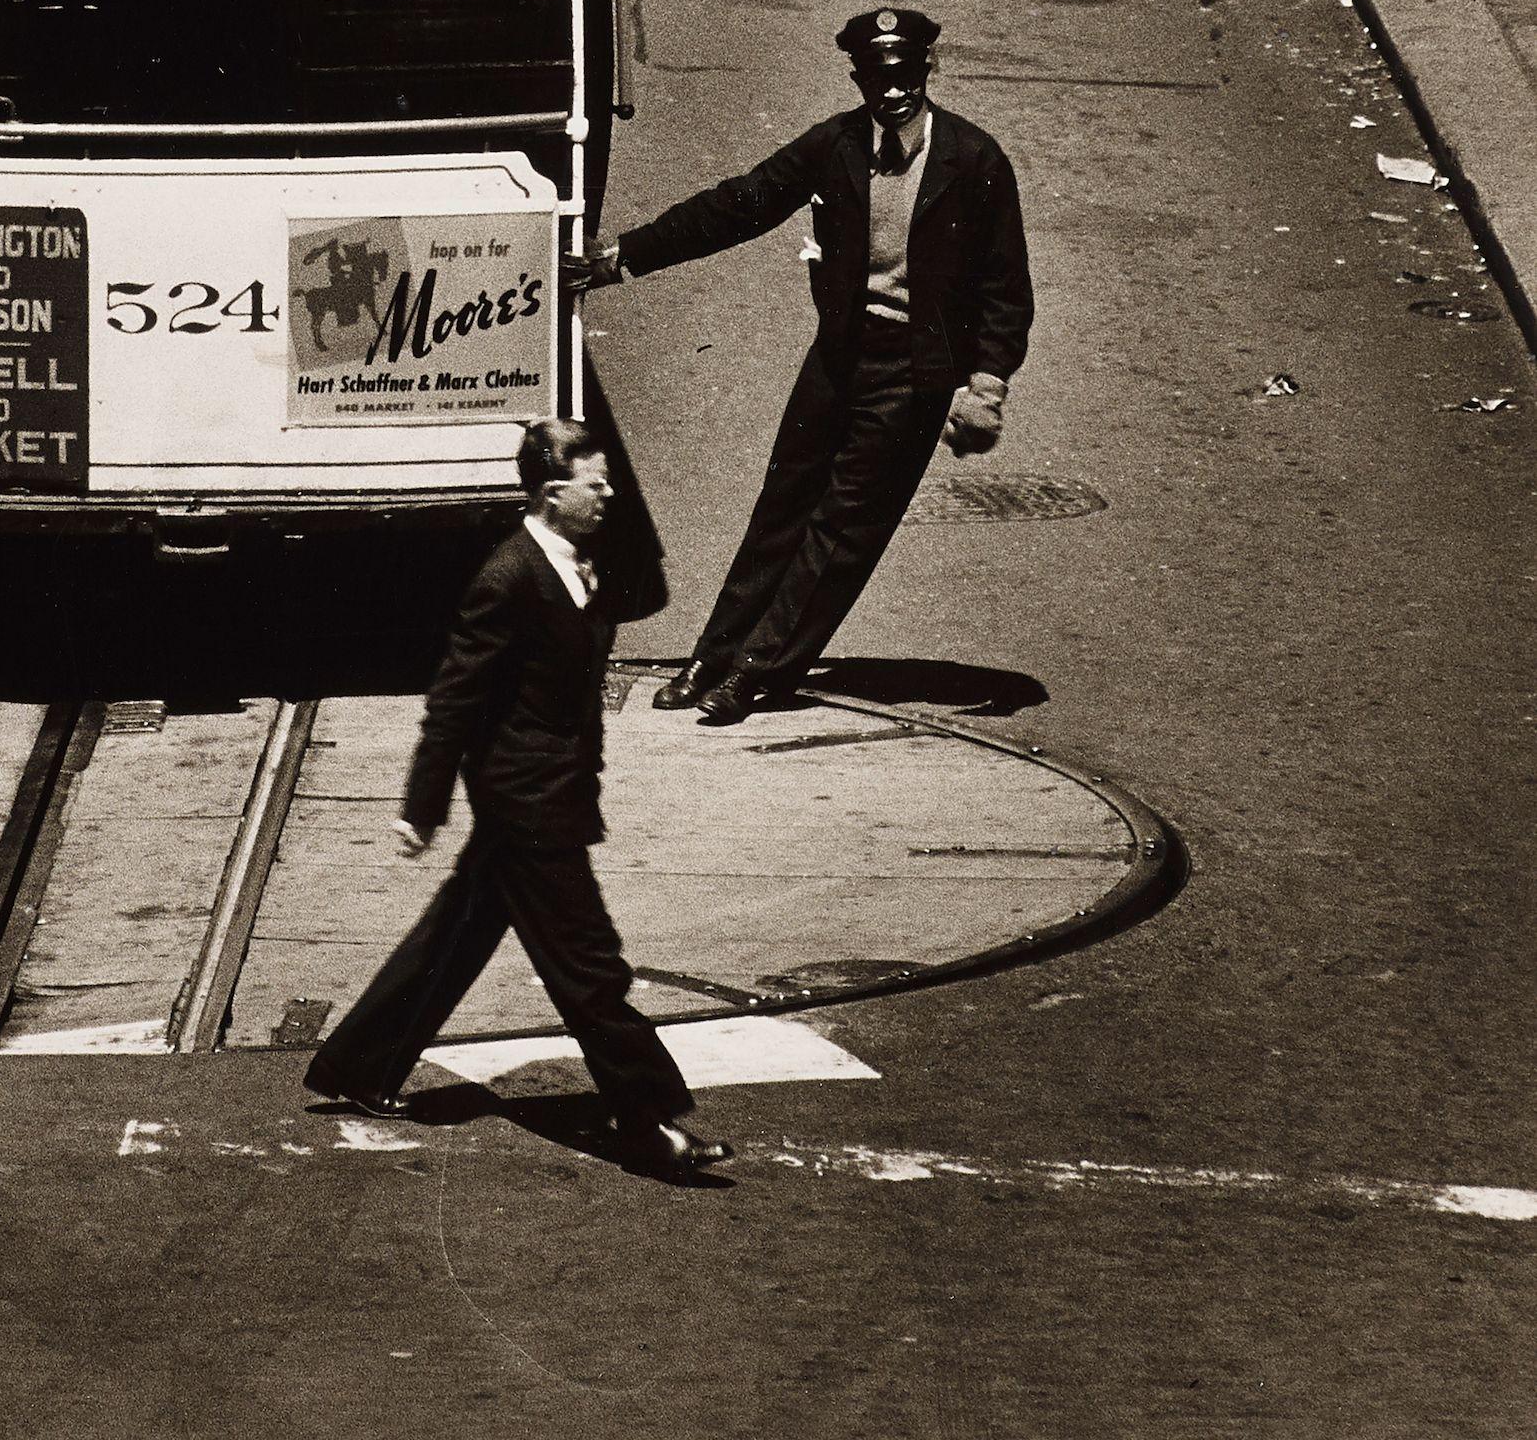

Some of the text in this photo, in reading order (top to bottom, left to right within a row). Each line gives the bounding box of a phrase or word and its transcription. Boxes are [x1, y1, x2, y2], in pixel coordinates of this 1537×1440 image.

[429, 239, 510, 260] hop on for
[106, 279, 280, 334] 524
[365, 269, 542, 365] Moore's
[298, 368, 540, 394] Hart Schaffner & Marx Clothes
[364, 402, 415, 412] MARKET
